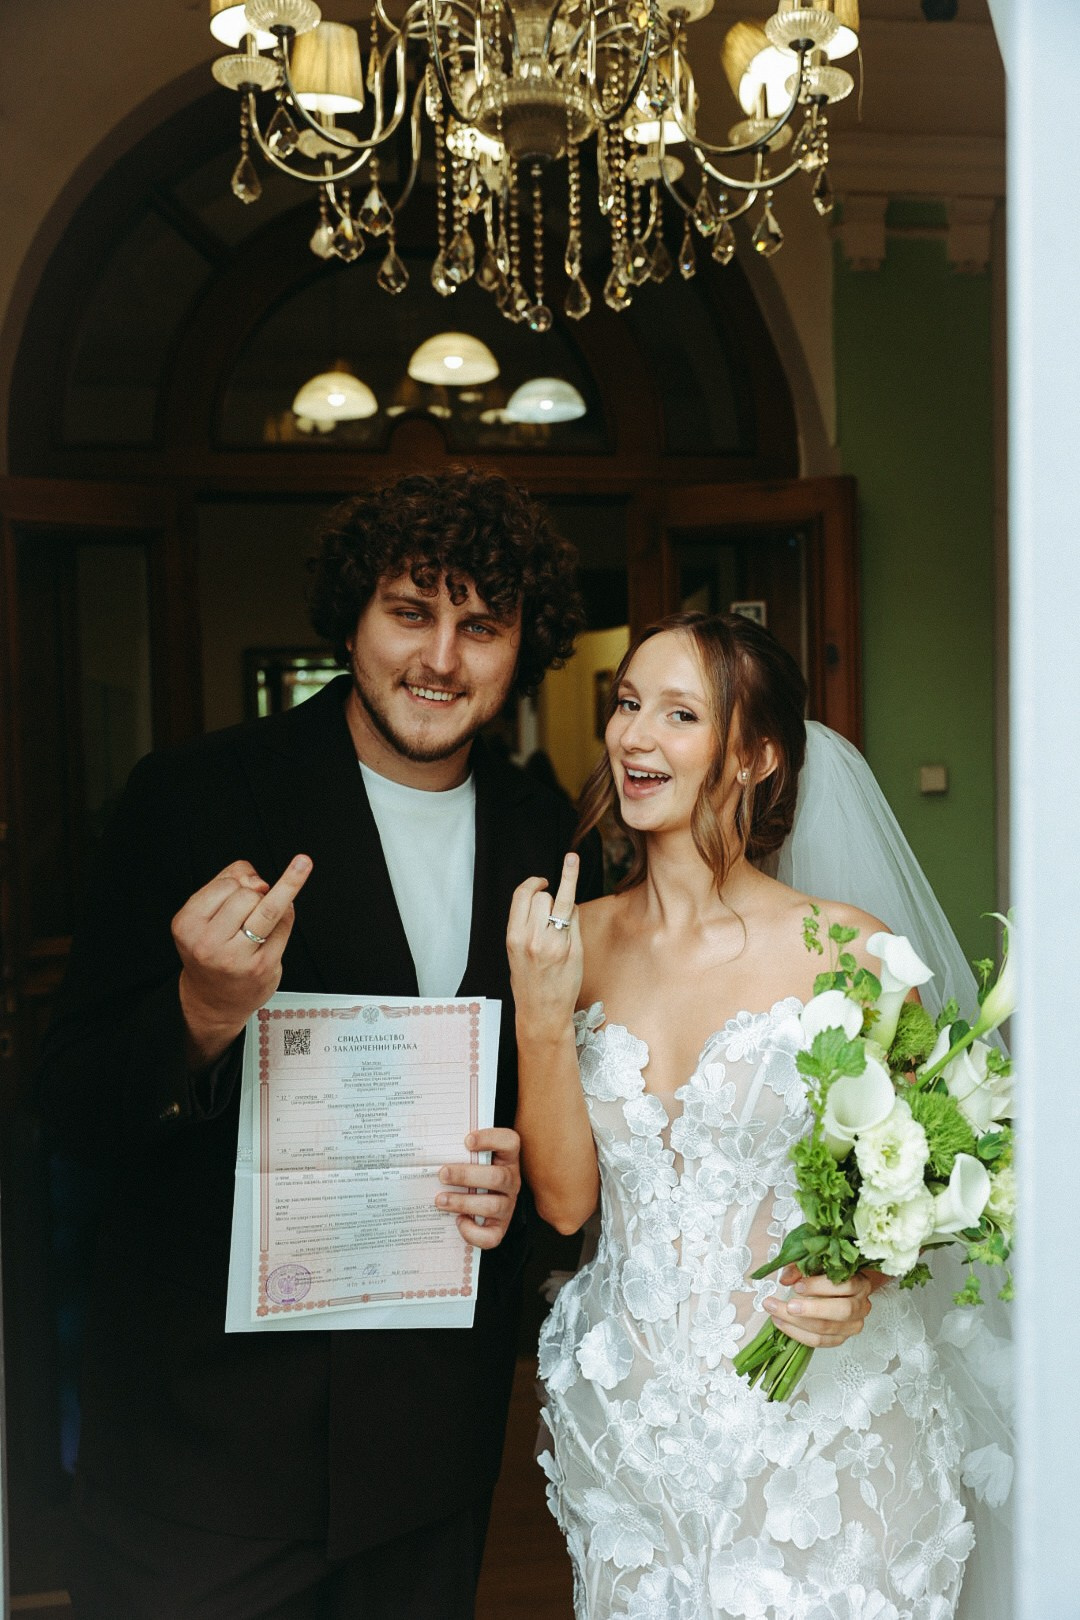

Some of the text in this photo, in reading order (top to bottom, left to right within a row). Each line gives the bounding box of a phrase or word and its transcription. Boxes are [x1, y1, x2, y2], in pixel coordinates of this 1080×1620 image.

[337, 1034, 405, 1043] СВИДЕТЕЛЬСТВО
[323, 1045, 331, 1053] О
[332, 1044, 390, 1052] ЗАКЛЮЧЕНИИ
